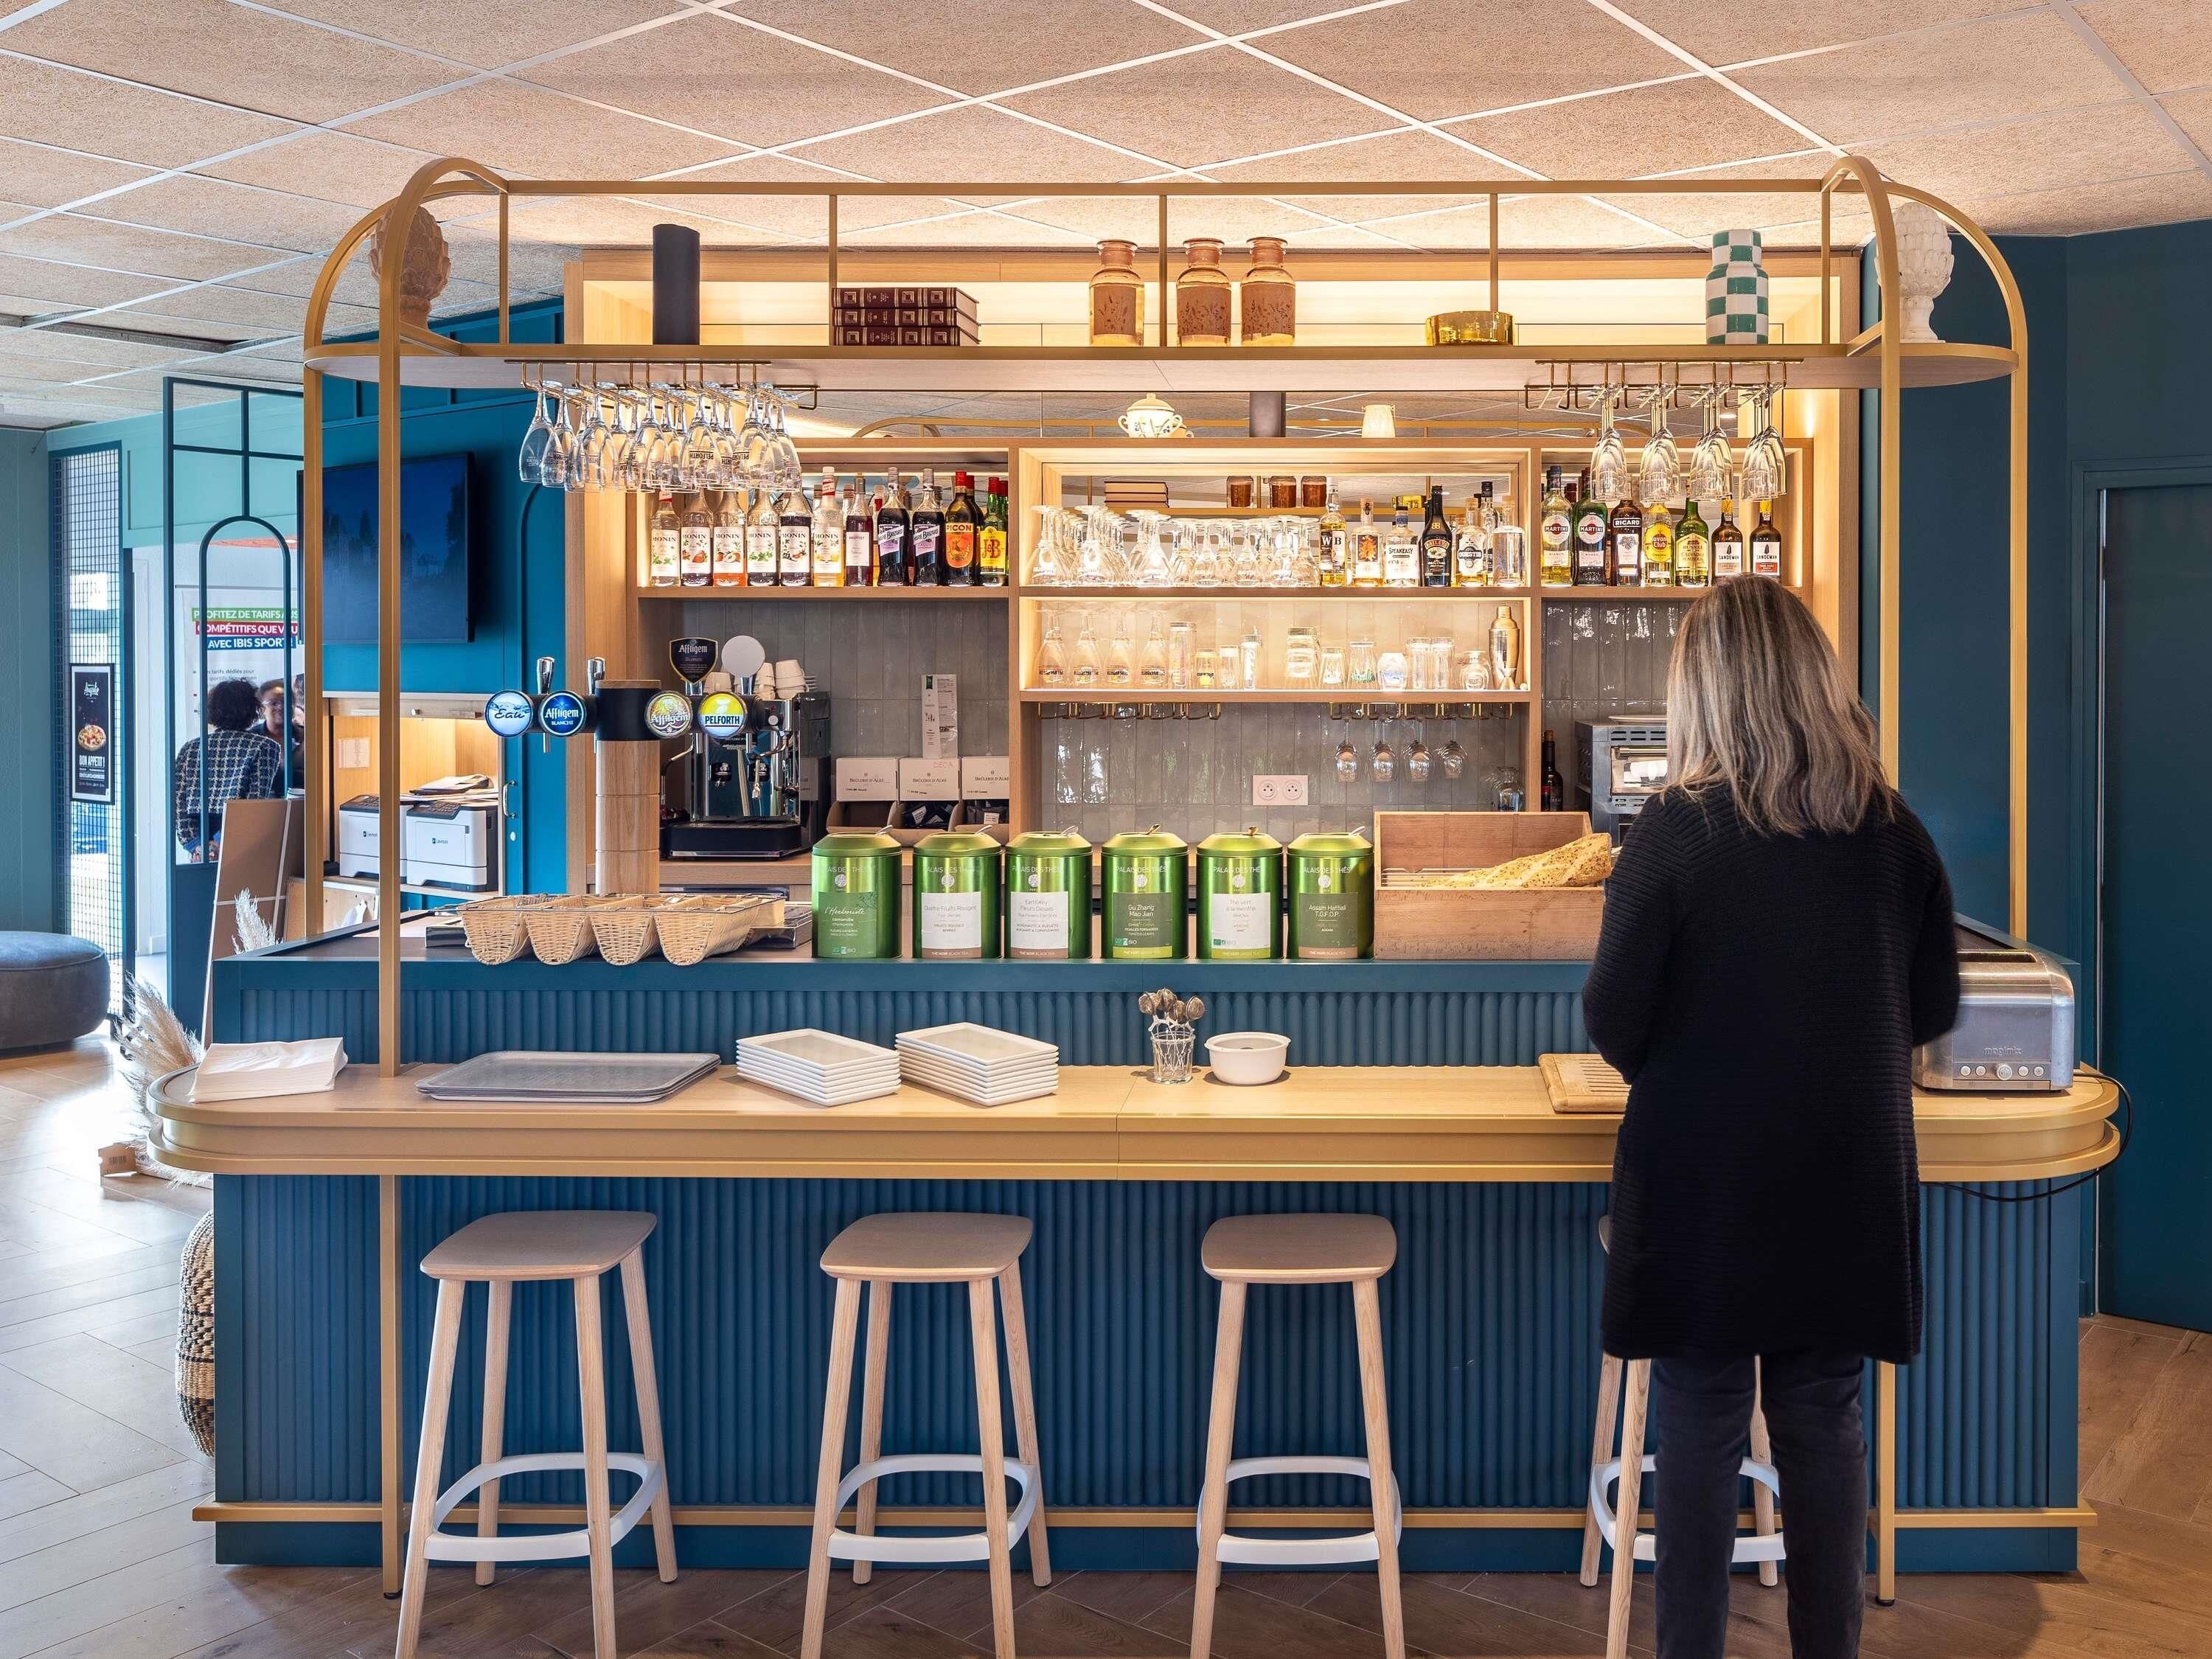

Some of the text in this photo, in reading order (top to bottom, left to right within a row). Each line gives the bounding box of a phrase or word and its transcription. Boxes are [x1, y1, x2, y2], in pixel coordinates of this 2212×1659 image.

[1321, 535, 1341, 546] W B
[1426, 539, 1448, 548] BAILEYS
[194, 610, 237, 619] POFITEZ
[238, 611, 251, 619] DE
[252, 611, 280, 619] TARIFS
[257, 625, 277, 634] QUE
[208, 639, 232, 648] AVEC
[234, 638, 253, 647] IBIS
[678, 644, 708, 655] Affligem
[494, 708, 526, 720] Eau
[545, 707, 579, 720] Affligem
[649, 713, 689, 726] Affligem
[704, 715, 740, 725] PELFORTH
[1983, 1046, 2023, 1057] magimix
